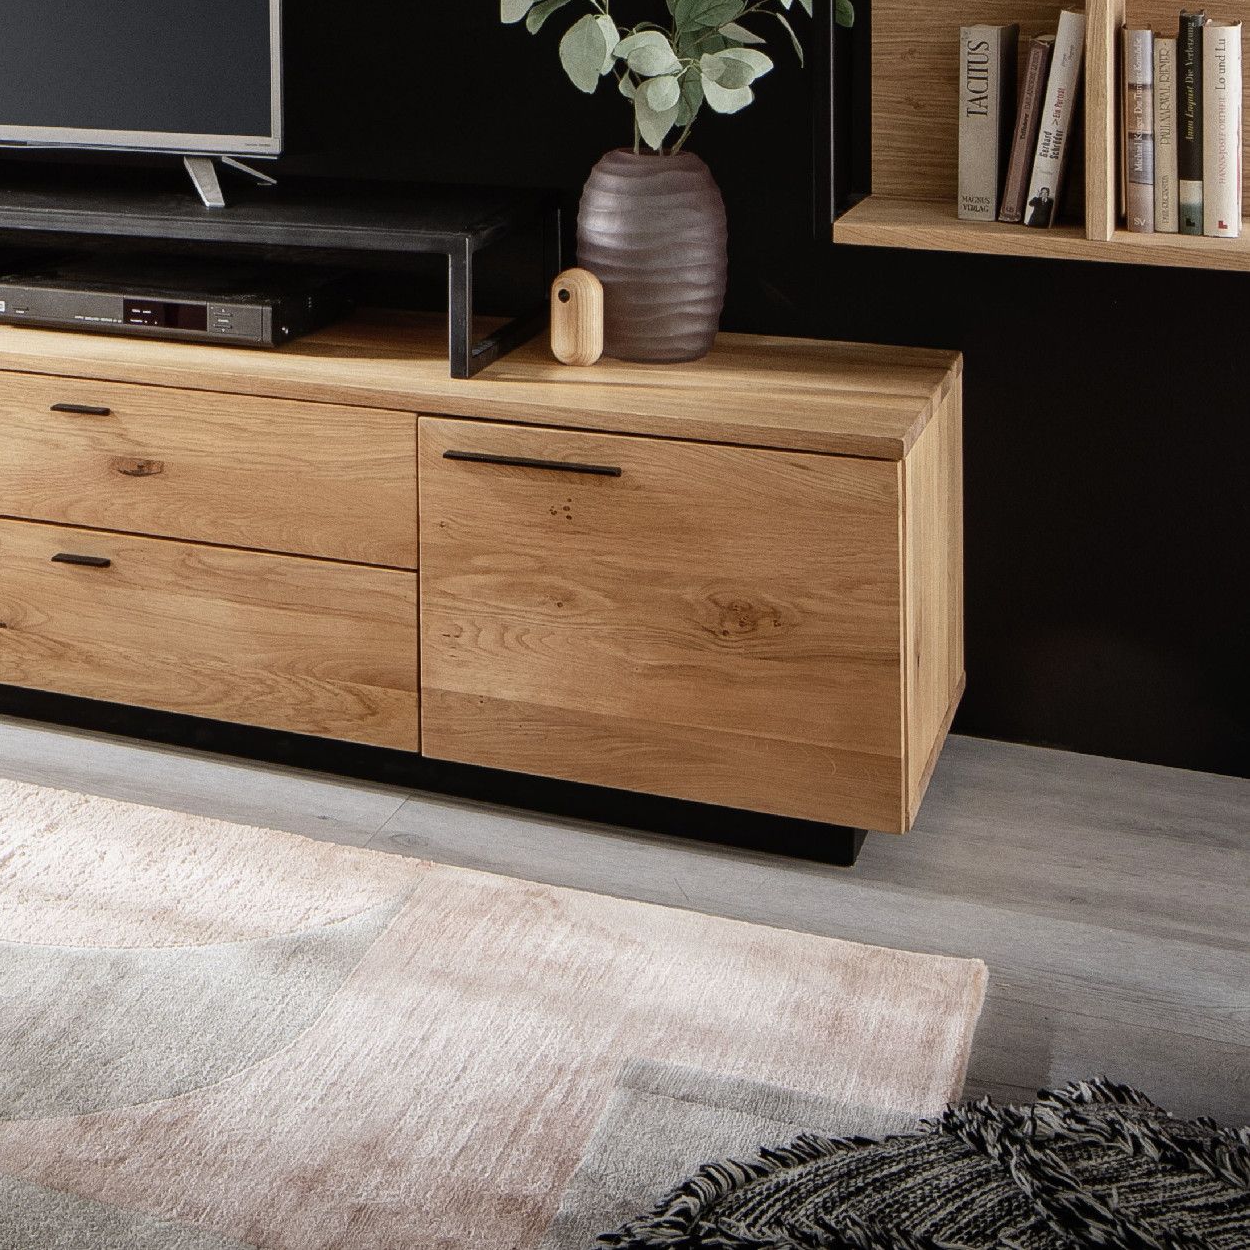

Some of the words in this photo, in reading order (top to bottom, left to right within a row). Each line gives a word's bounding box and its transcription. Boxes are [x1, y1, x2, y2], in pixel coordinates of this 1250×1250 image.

[1215, 38, 1226, 52] Lu
[1215, 55, 1226, 74] und
[966, 40, 990, 118] TACITUS
[1185, 68, 1194, 83] Die
[1215, 77, 1226, 90] Lo
[1134, 100, 1143, 113] Die
[1185, 121, 1194, 140] Anna
[1039, 131, 1052, 158] Gerhard
[1049, 130, 1064, 159] Schröder
[1134, 142, 1143, 172] Michael
